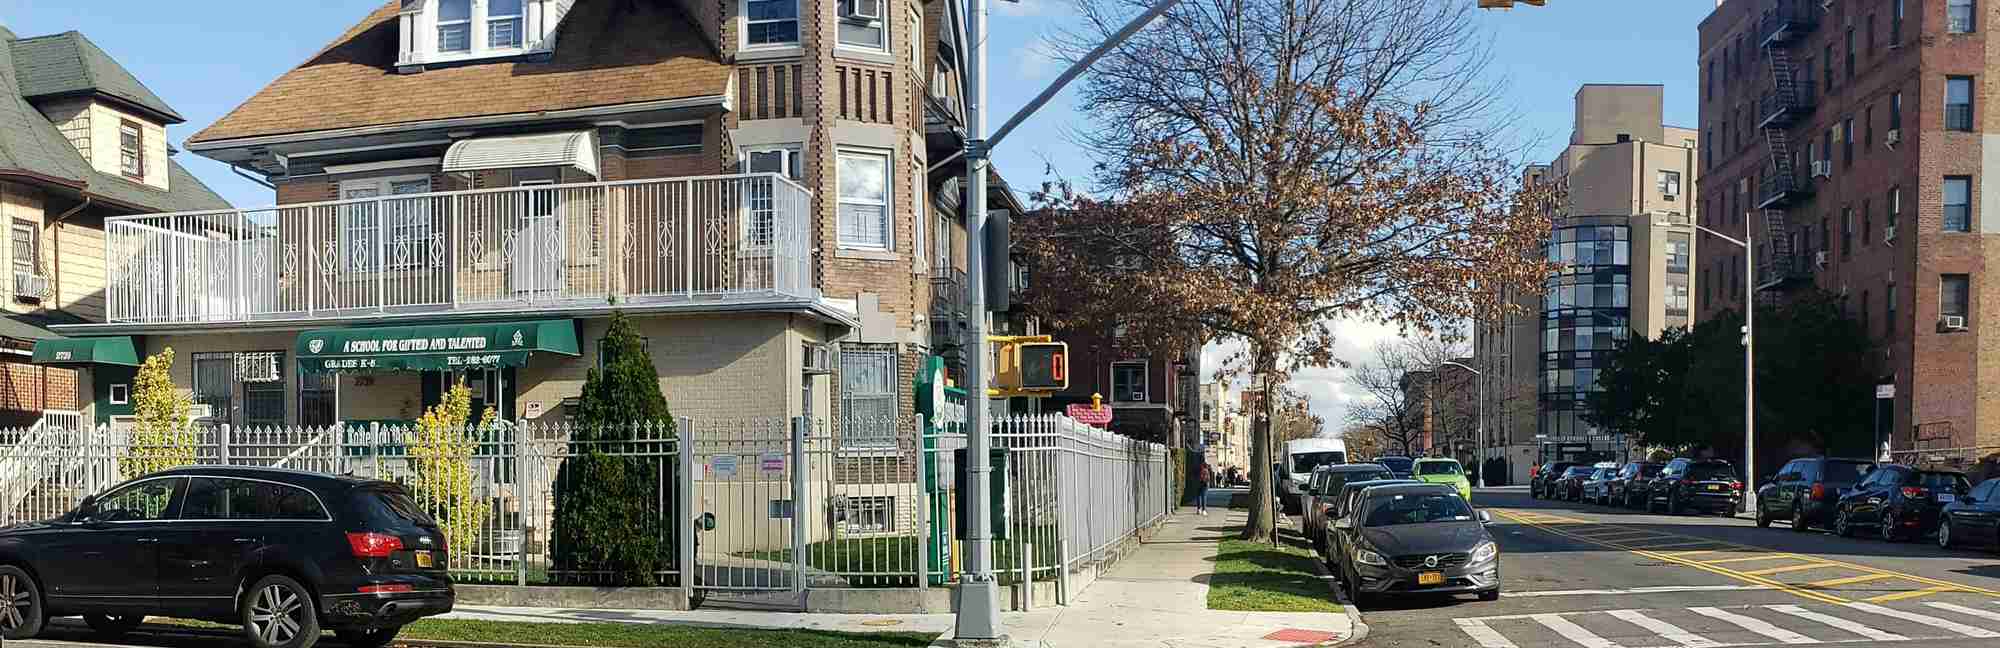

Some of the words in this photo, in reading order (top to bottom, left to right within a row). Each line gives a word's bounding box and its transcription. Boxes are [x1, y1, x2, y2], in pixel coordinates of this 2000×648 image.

[343, 340, 350, 353] A
[350, 339, 381, 353] SCHOOL
[382, 339, 398, 352] FOR
[398, 338, 429, 351] GIFTED
[429, 337, 446, 351] AND
[447, 336, 487, 350] TALENTED
